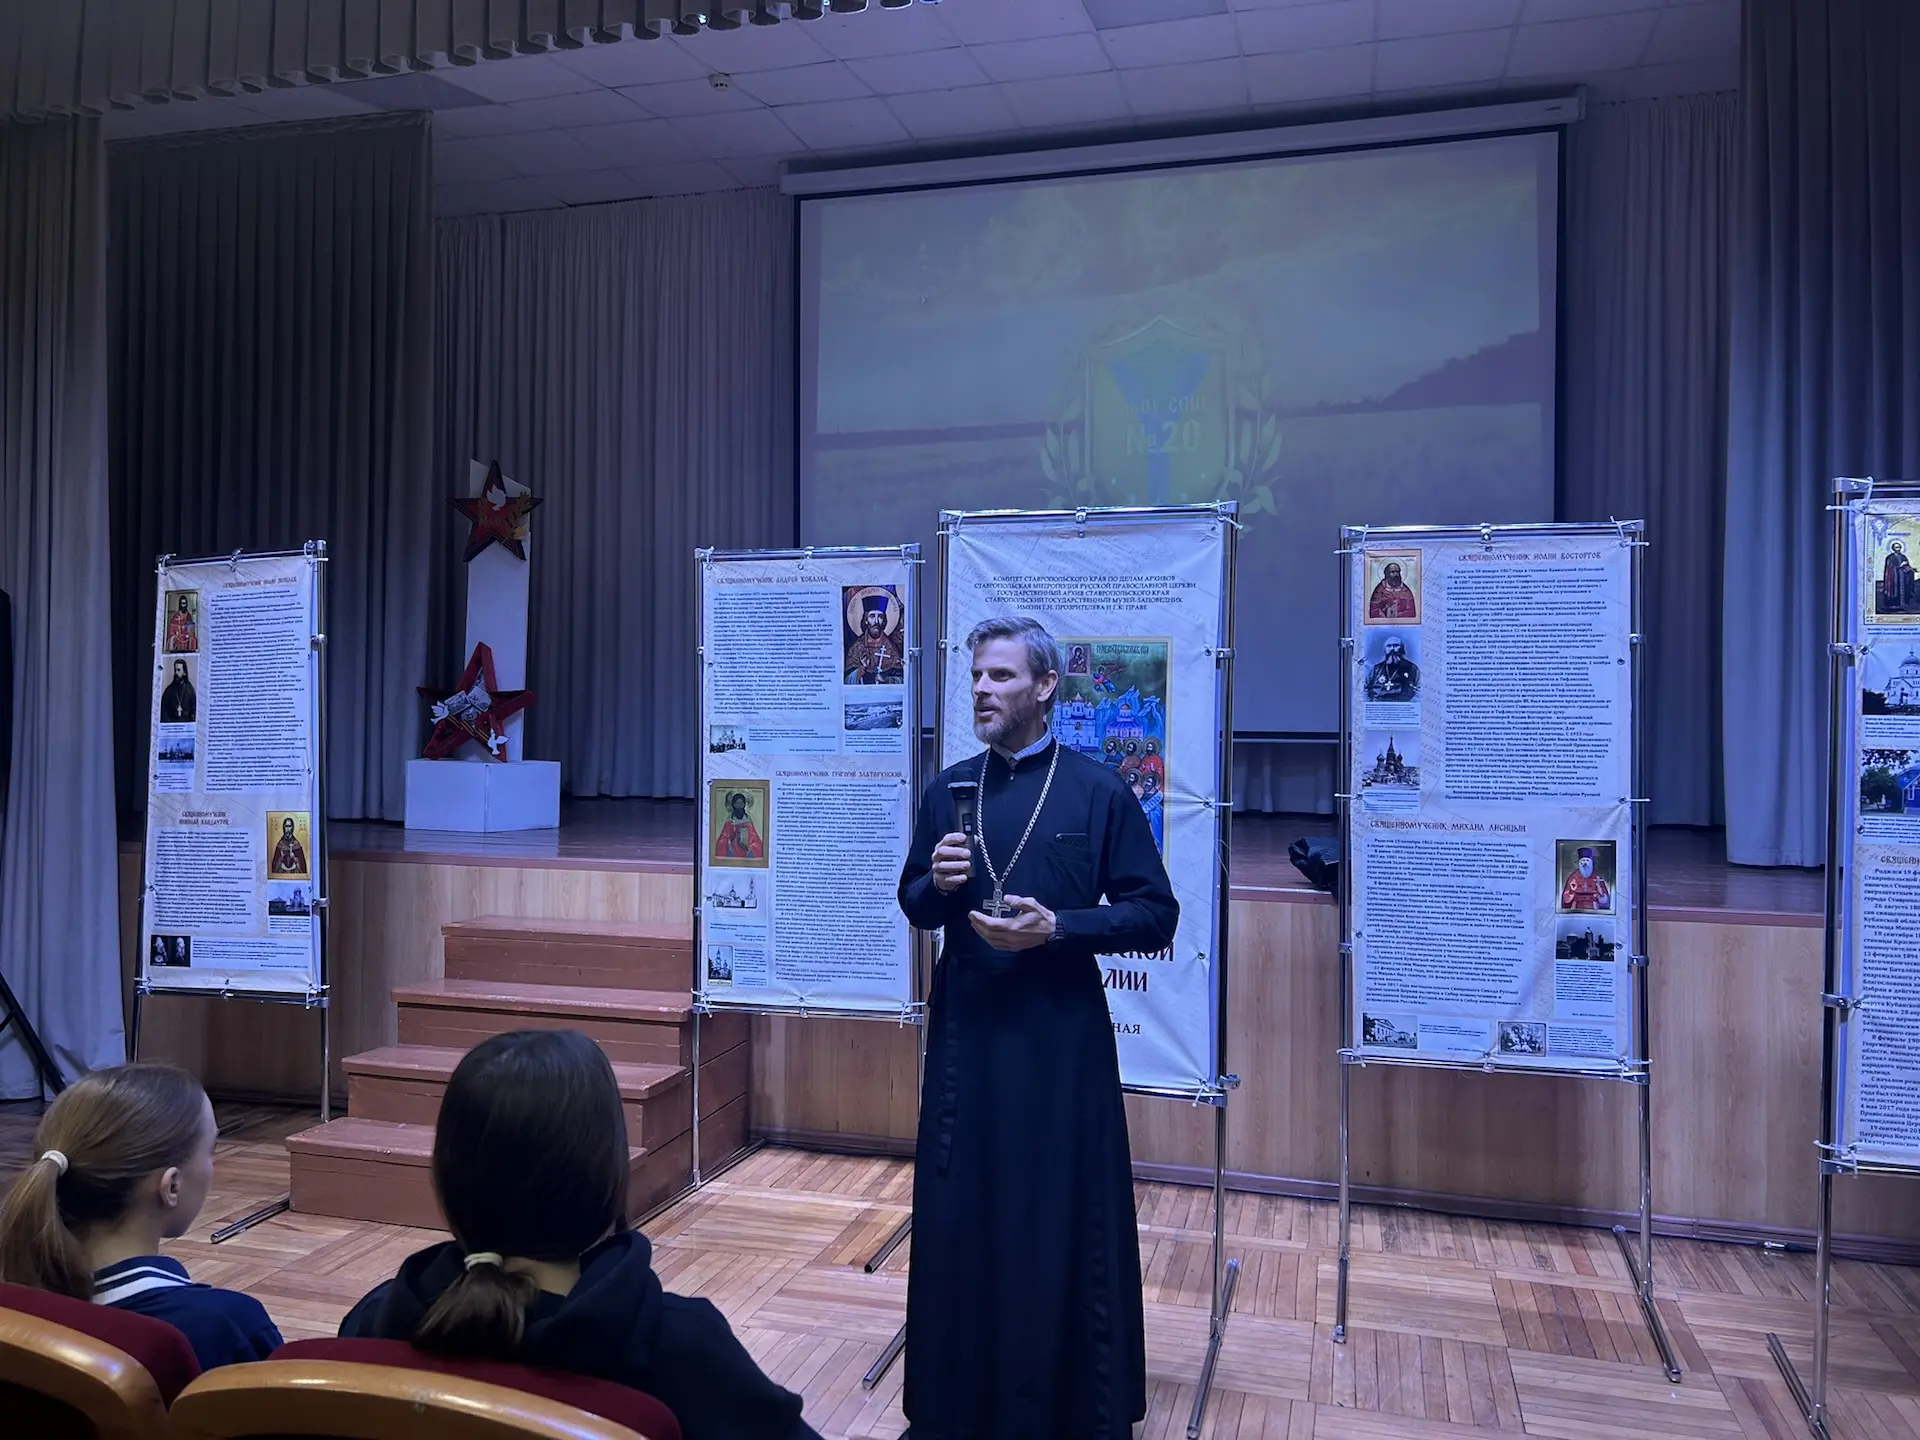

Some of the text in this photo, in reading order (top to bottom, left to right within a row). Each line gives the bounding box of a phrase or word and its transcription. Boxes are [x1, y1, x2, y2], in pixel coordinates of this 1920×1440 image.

[1560, 551, 1602, 560] ВОСТОРГОВ
[1877, 1035, 1907, 1043] феврале
[1862, 1041, 1907, 1049] Георгиевской
[1860, 1110, 1906, 1119] Православной
